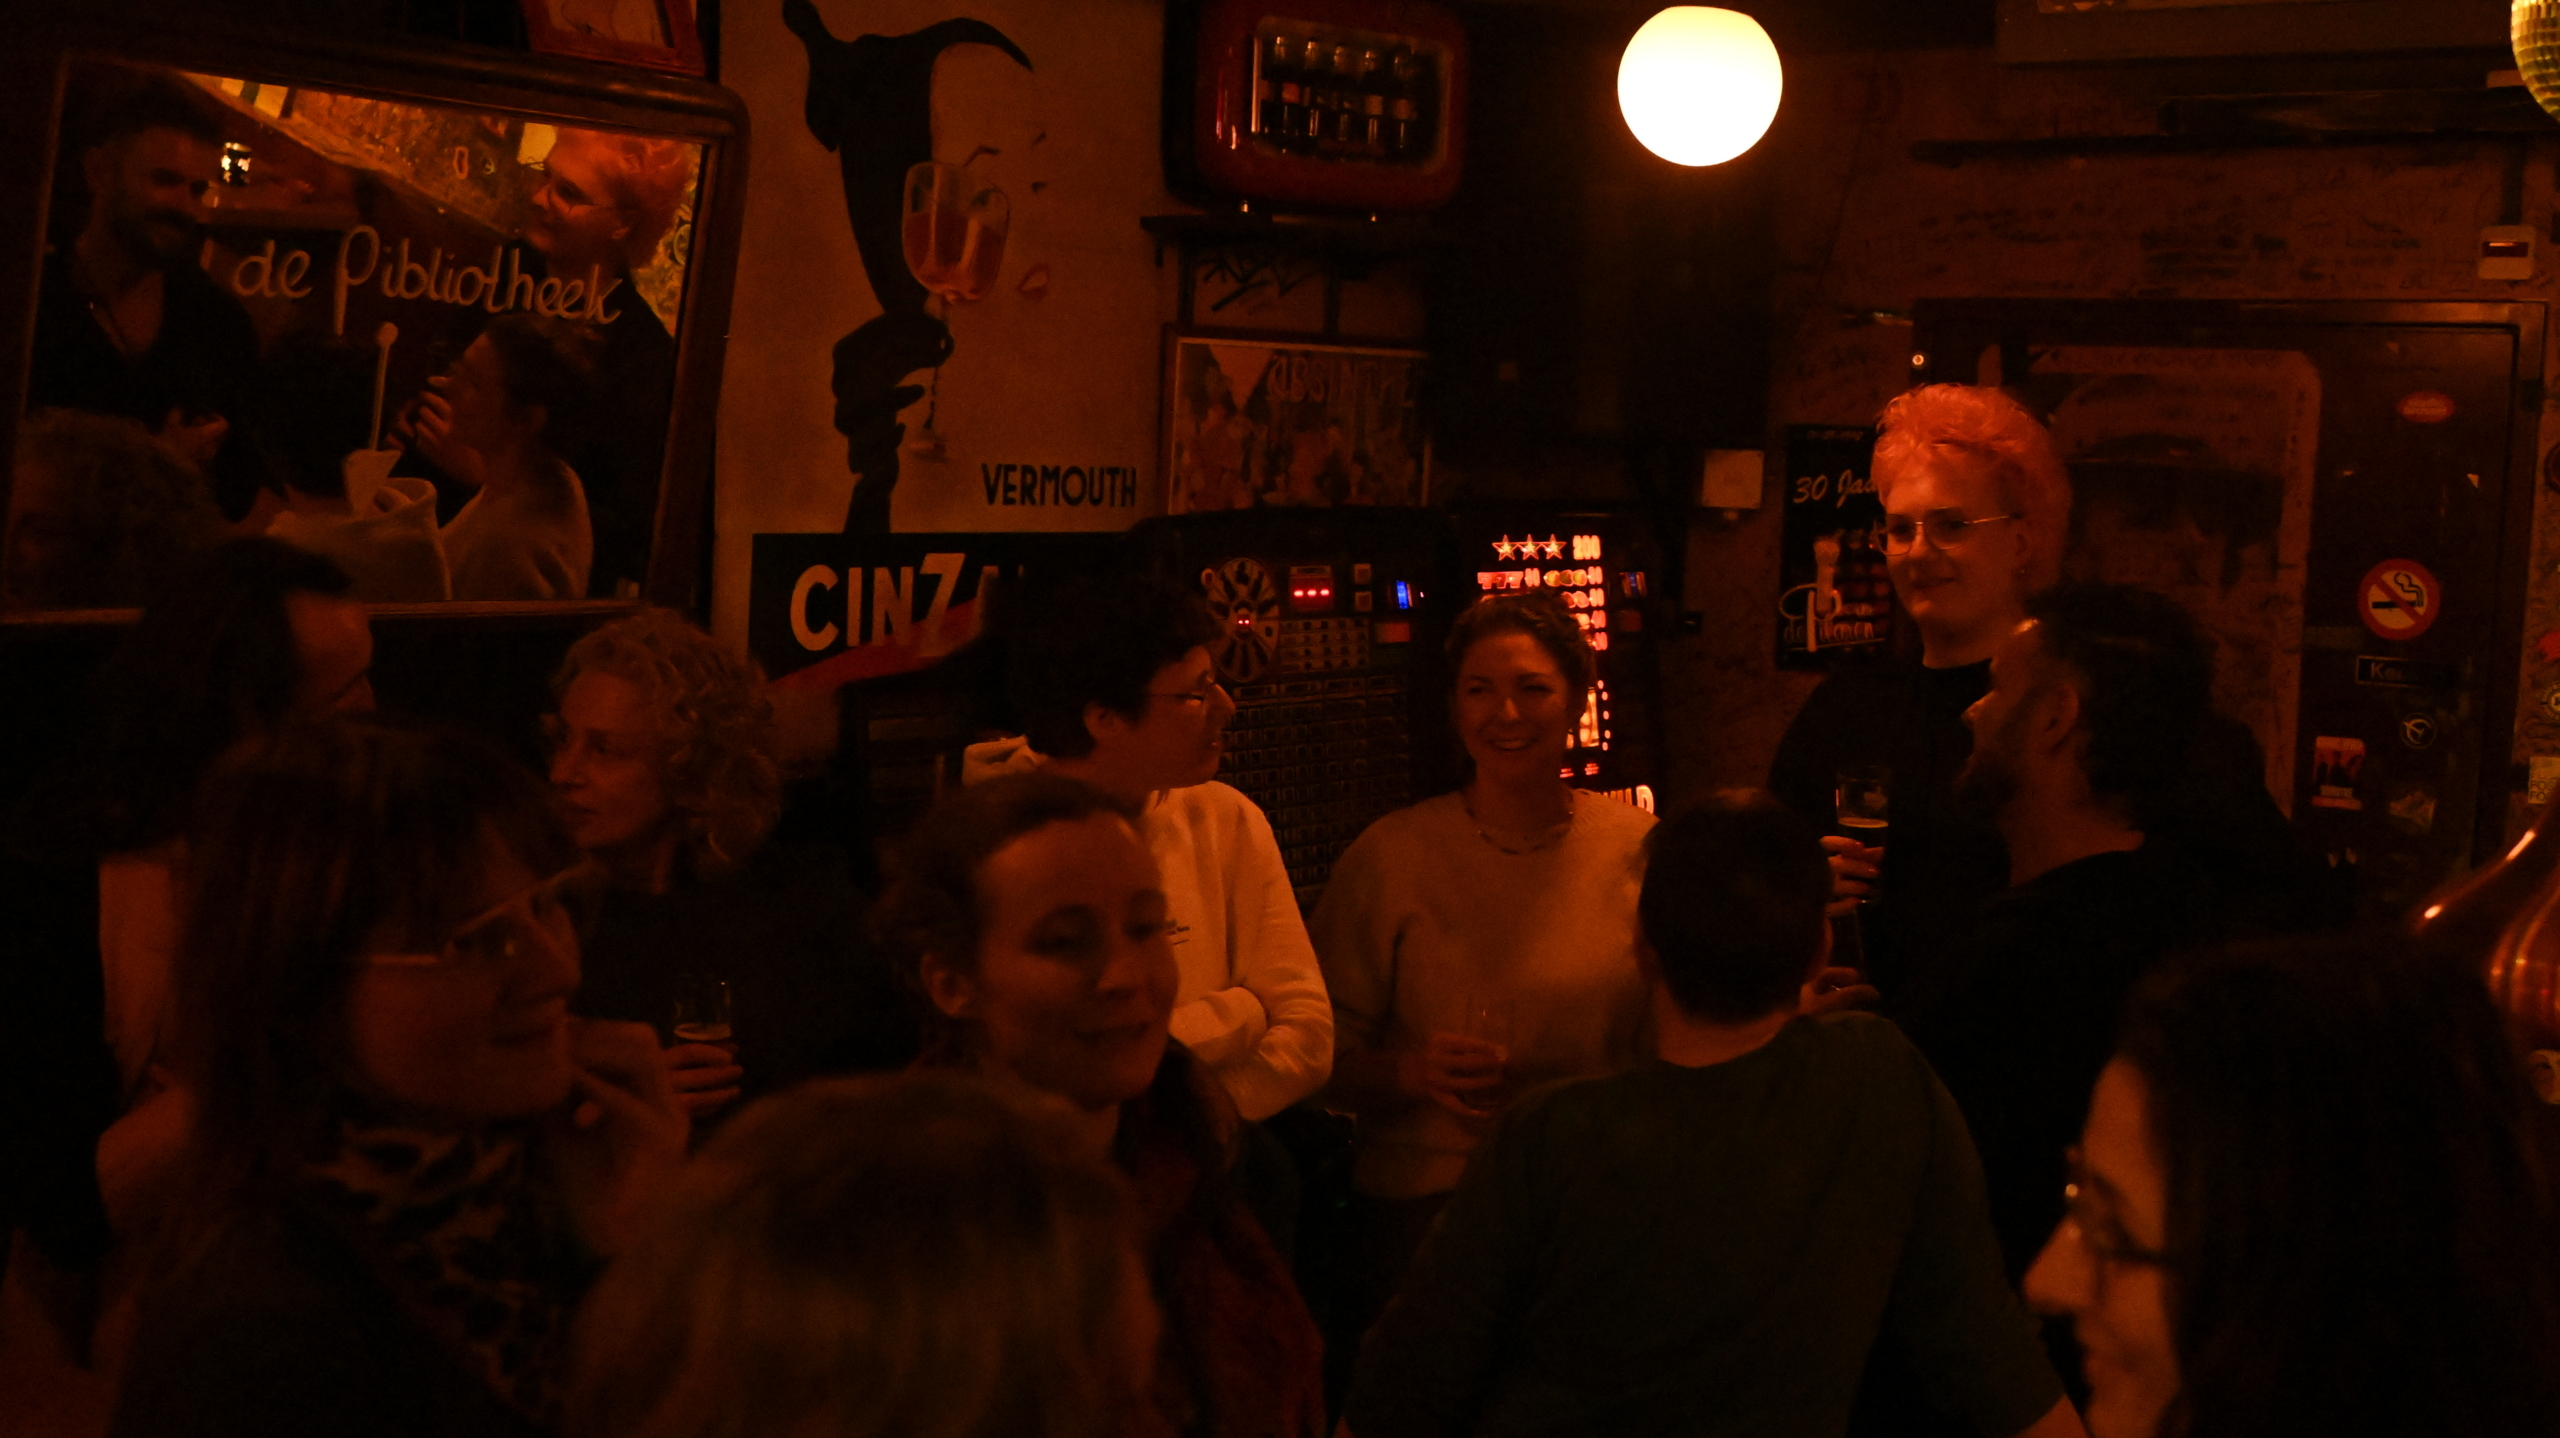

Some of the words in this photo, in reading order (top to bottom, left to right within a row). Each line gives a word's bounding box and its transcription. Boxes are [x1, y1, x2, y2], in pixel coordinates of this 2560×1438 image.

[231, 238, 313, 299] de
[333, 224, 622, 337] Pibliotheek
[981, 462, 1137, 508] VERMOUTH
[1793, 473, 1828, 504] 30
[1836, 468, 1878, 509] Jaa
